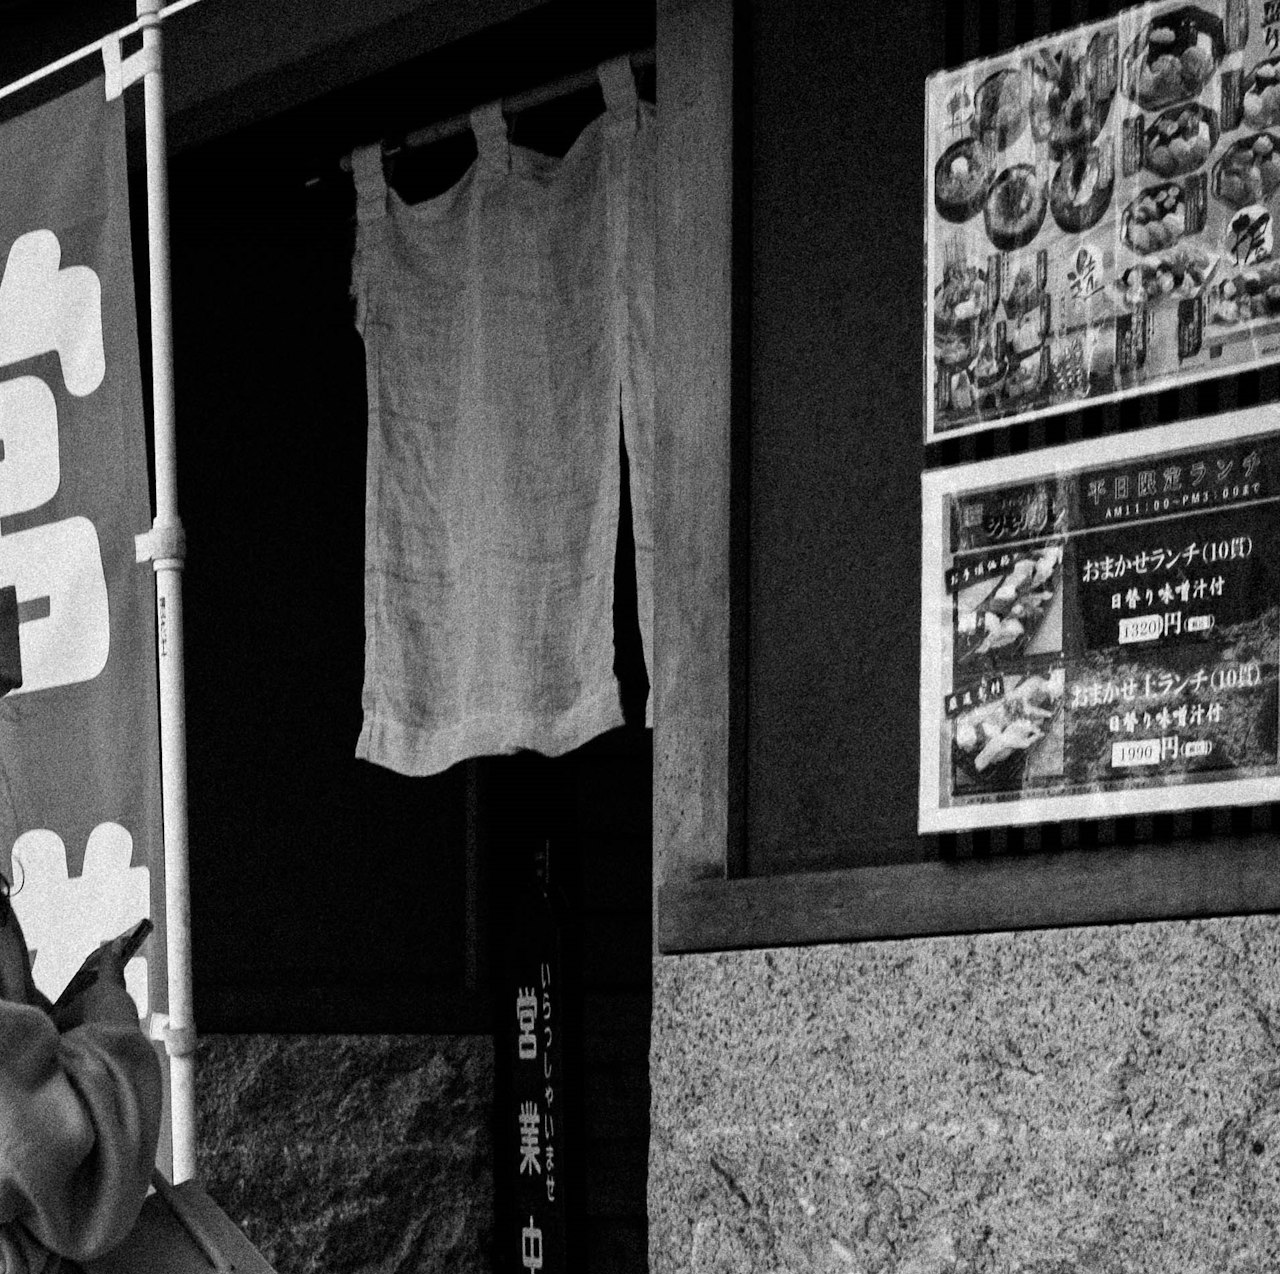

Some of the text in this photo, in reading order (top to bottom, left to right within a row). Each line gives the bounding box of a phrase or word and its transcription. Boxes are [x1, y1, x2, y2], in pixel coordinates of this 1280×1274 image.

[1085, 451, 1262, 506] 平日限定ランチ
